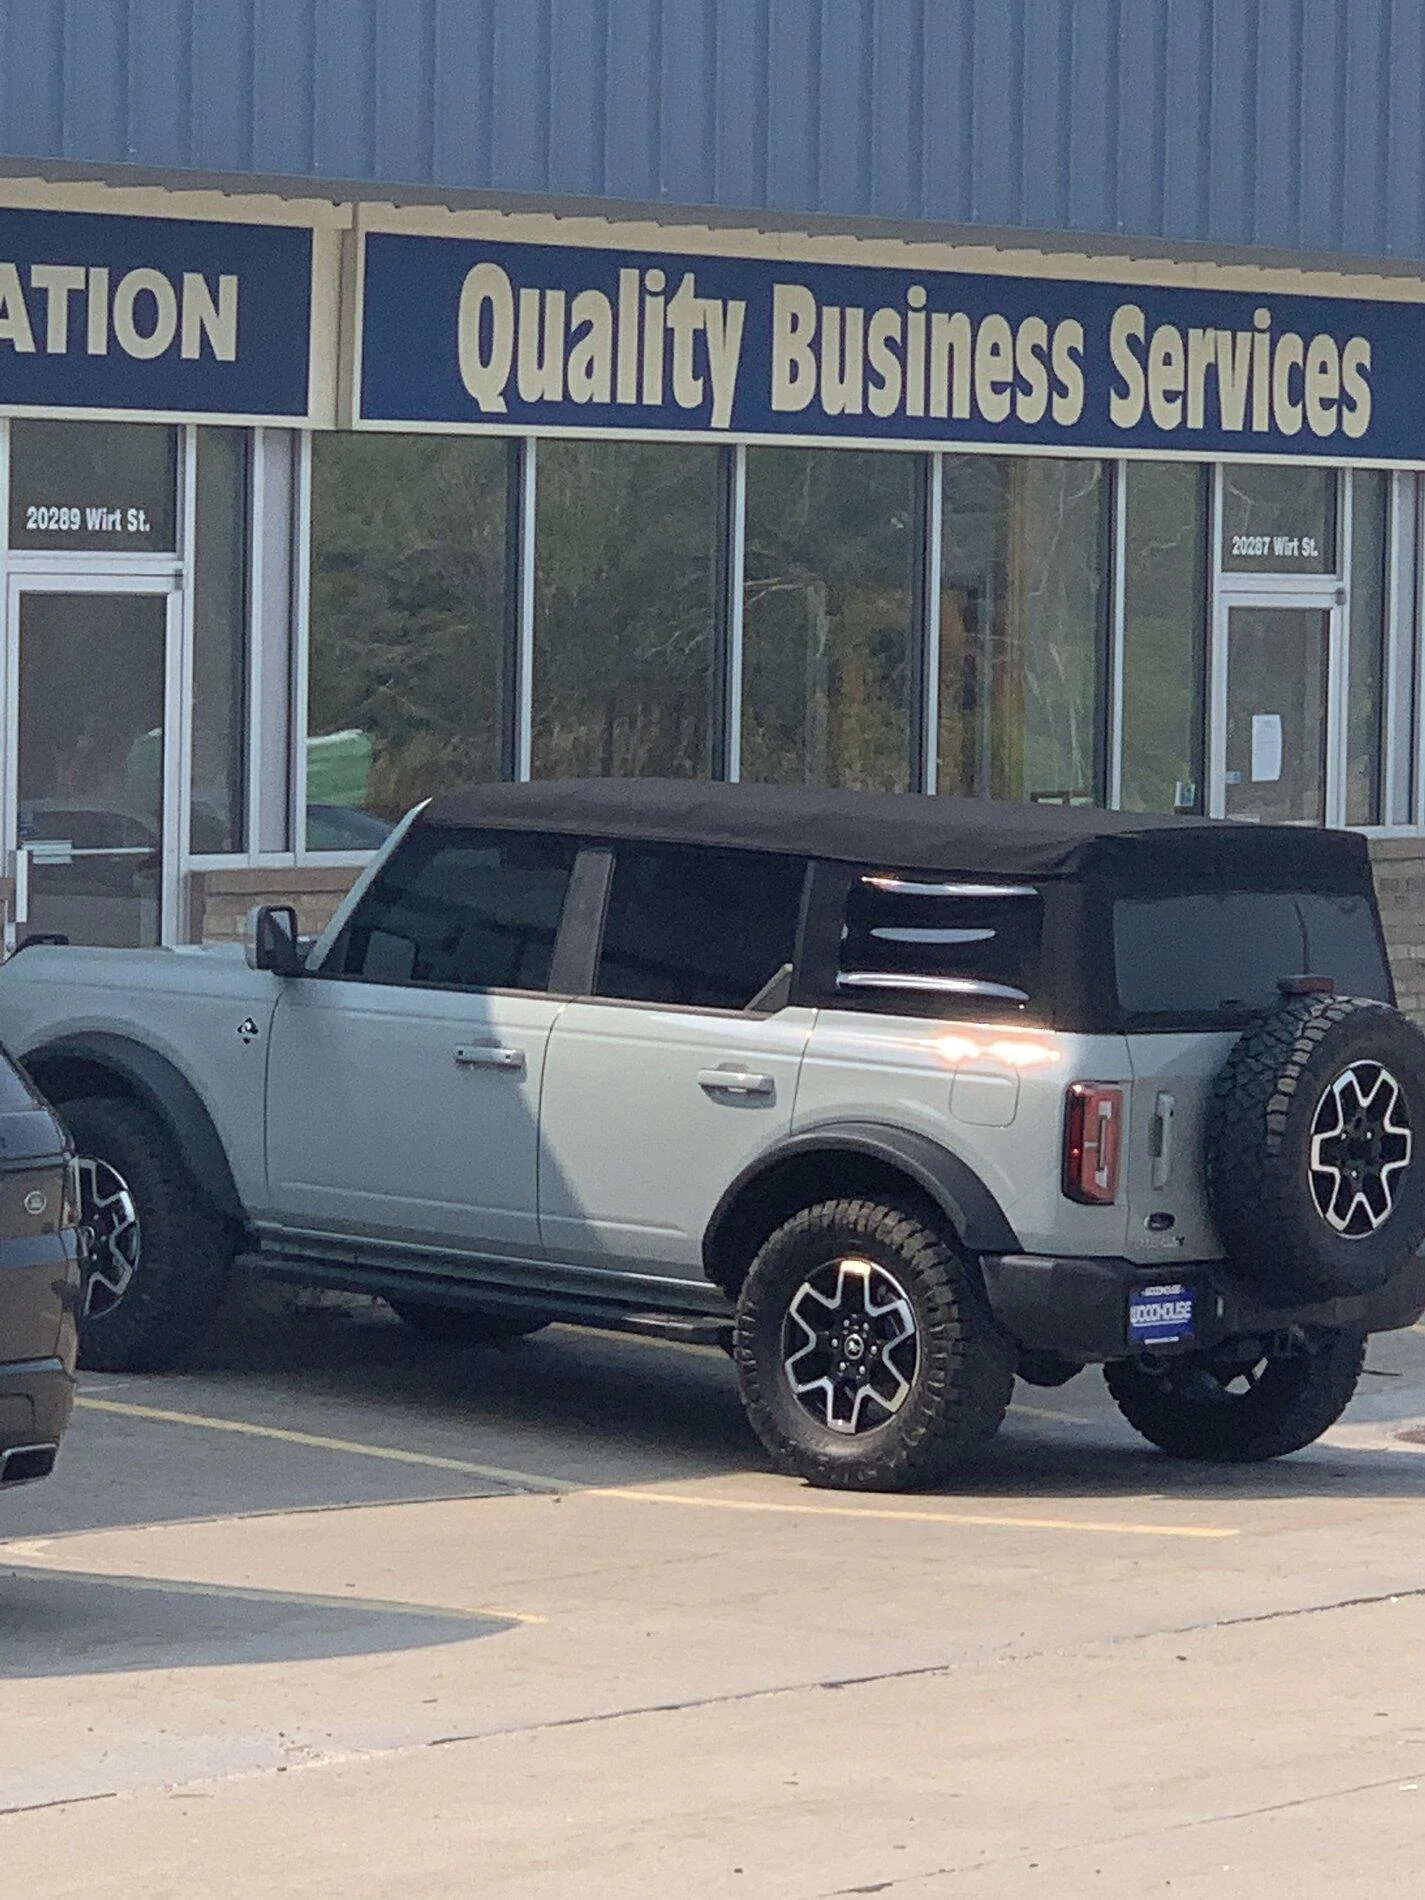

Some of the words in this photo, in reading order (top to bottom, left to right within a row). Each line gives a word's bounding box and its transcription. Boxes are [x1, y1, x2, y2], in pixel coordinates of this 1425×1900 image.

[0, 263, 238, 361] ATION
[458, 262, 746, 428] Quality
[771, 284, 1085, 426] Business
[1109, 304, 1372, 438] Services
[26, 506, 80, 531] 20289
[86, 507, 122, 531] Wirt
[127, 508, 150, 532] St.
[1273, 536, 1299, 557] Wirt
